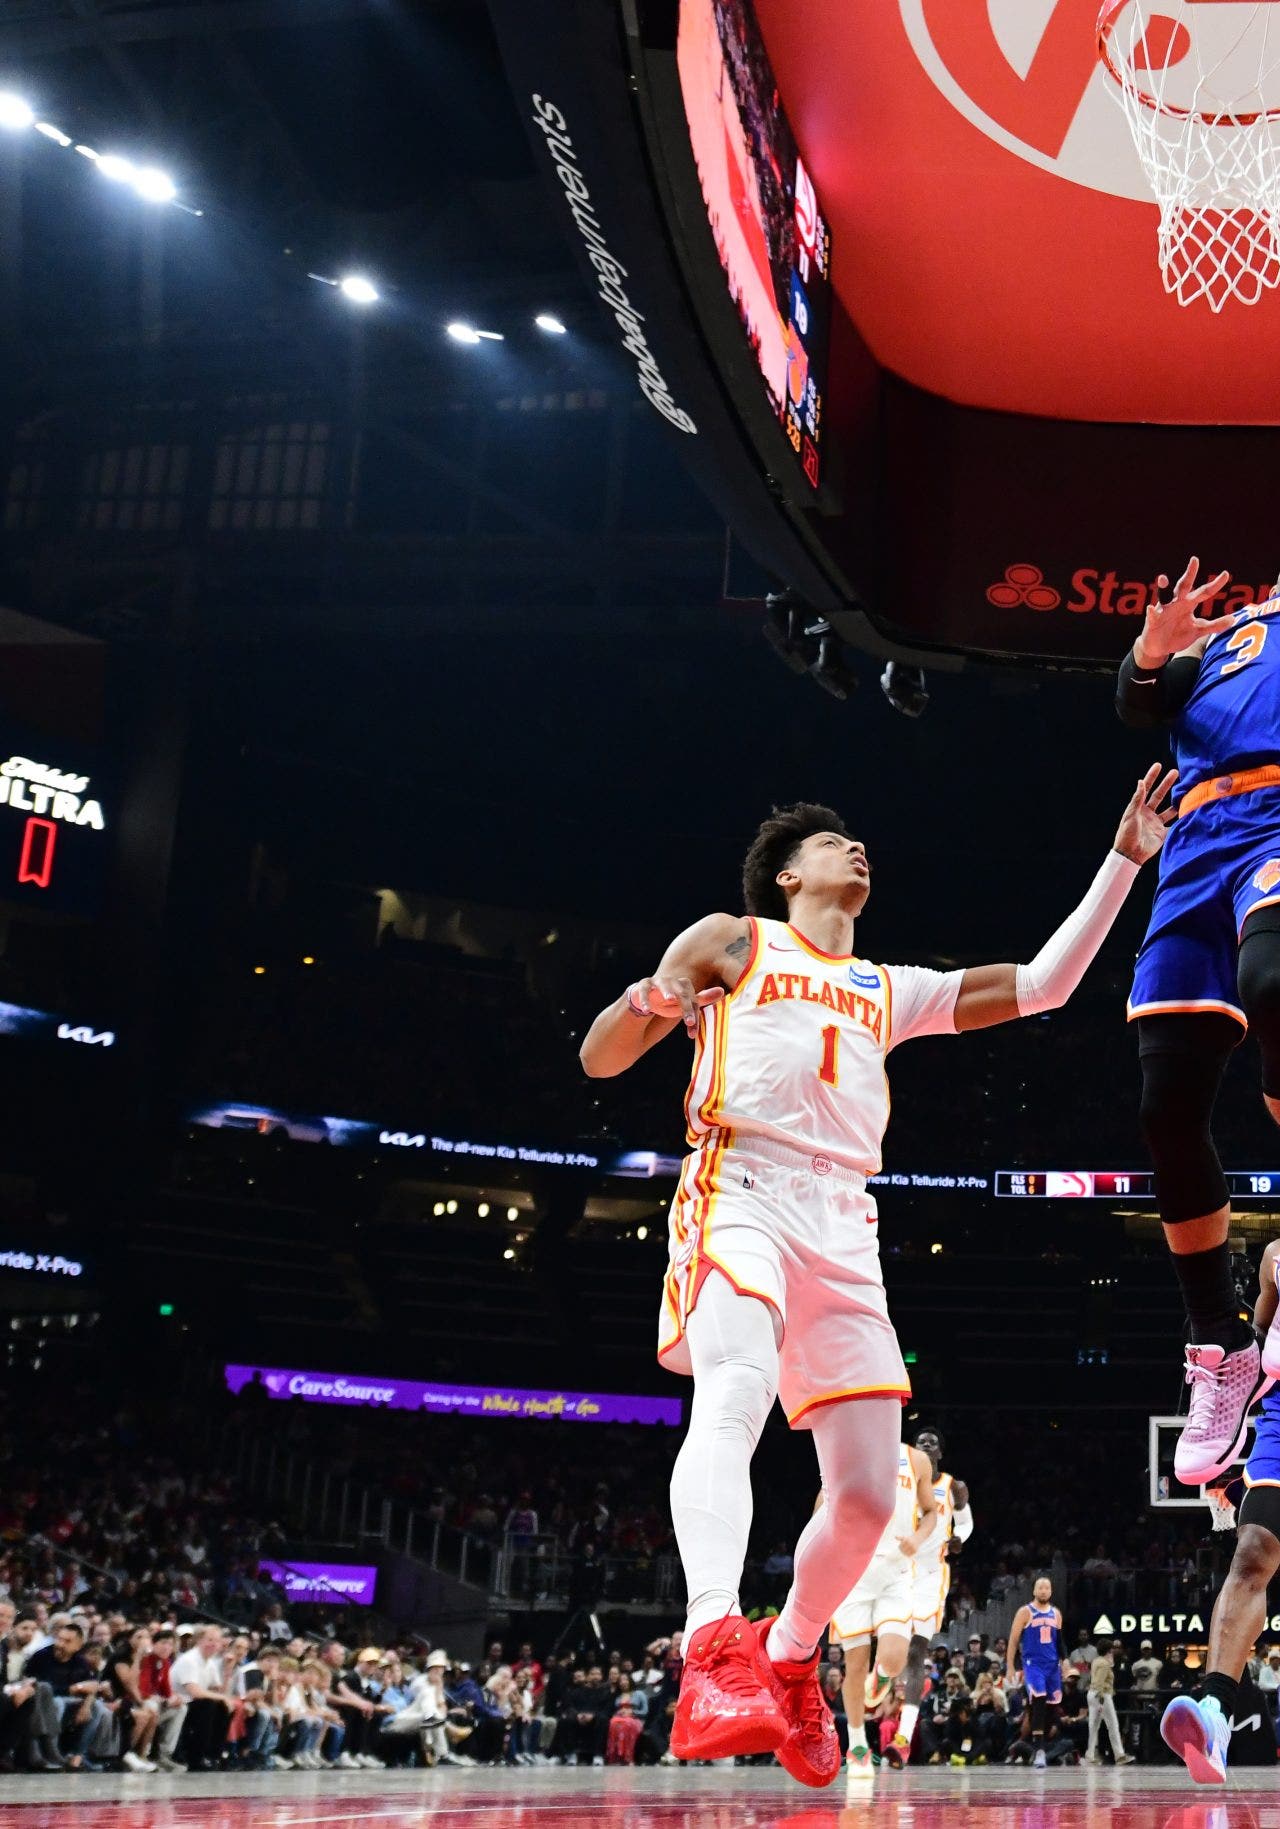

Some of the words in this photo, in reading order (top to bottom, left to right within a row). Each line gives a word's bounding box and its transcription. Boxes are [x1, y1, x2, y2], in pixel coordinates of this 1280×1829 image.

[1066, 568, 1157, 616] Sta
[1221, 620, 1268, 675] 3
[757, 973, 883, 1045] ATLANTA
[818, 1024, 840, 1088] 1
[432, 1137, 452, 1151] The
[454, 1142, 496, 1156] all-new
[498, 1146, 516, 1158] Kia
[518, 1148, 564, 1164] Telluride
[566, 1154, 598, 1167] X-Pro
[892, 1175, 909, 1186] Kia
[911, 1175, 955, 1188] Telluride
[957, 1177, 988, 1188] X-Pro
[1010, 1175, 1026, 1184] FLS
[1010, 1185, 1027, 1195] TOL
[1114, 1176, 1130, 1194] 11
[1250, 1176, 1271, 1194] 19
[36, 1254, 82, 1276] X-Pro
[289, 1374, 395, 1402] CareSource
[1120, 1614, 1204, 1632] DELTA
